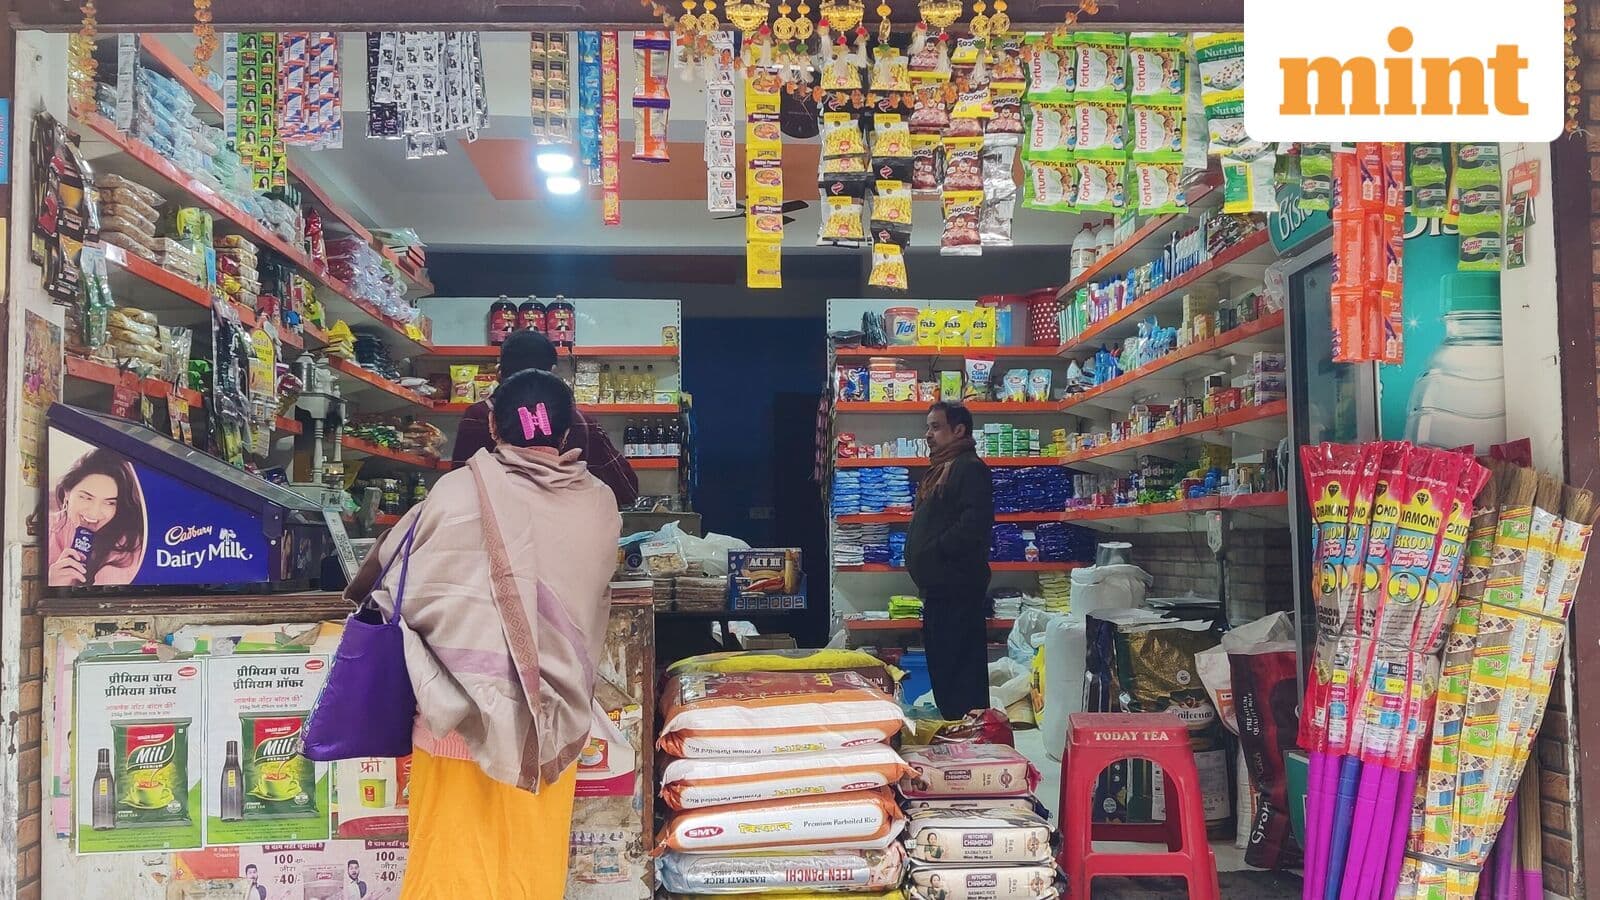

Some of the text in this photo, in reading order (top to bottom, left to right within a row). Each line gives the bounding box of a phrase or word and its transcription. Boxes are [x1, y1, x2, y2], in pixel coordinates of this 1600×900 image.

[1032, 50, 1042, 89] fortune
[1079, 50, 1090, 88] fortune
[1136, 53, 1146, 92] fortune
[1033, 110, 1043, 148] fortune
[1078, 108, 1089, 146] fortune
[1137, 111, 1148, 149] fortune
[1080, 165, 1090, 202] fortune
[1142, 169, 1152, 206] fortune
[896, 321, 916, 336] Tide
[920, 319, 936, 329] fab
[944, 319, 961, 329] fab
[164, 524, 213, 546] Cadbury
[156, 540, 253, 569] Dairy Milk
[749, 558, 767, 567] ACT
[109, 672, 172, 684] प्रीमियम चाय
[237, 665, 300, 677] प्रीमियम चाय
[105, 684, 177, 697] प्रीमियम ऑफर
[233, 677, 304, 690] प्रीमियम ऑफर
[1093, 731, 1169, 741] TODAY TEA
[135, 745, 167, 763] Mili
[263, 738, 294, 756] Mili
[688, 827, 720, 839] SMV
[803, 819, 833, 828] Premium
[864, 817, 878, 825] Rice
[274, 854, 294, 865] 100
[376, 851, 395, 862] 100
[703, 876, 725, 884] RICE
[785, 868, 855, 882] TEEN PANCHI
[967, 880, 997, 888] CHAMPION
